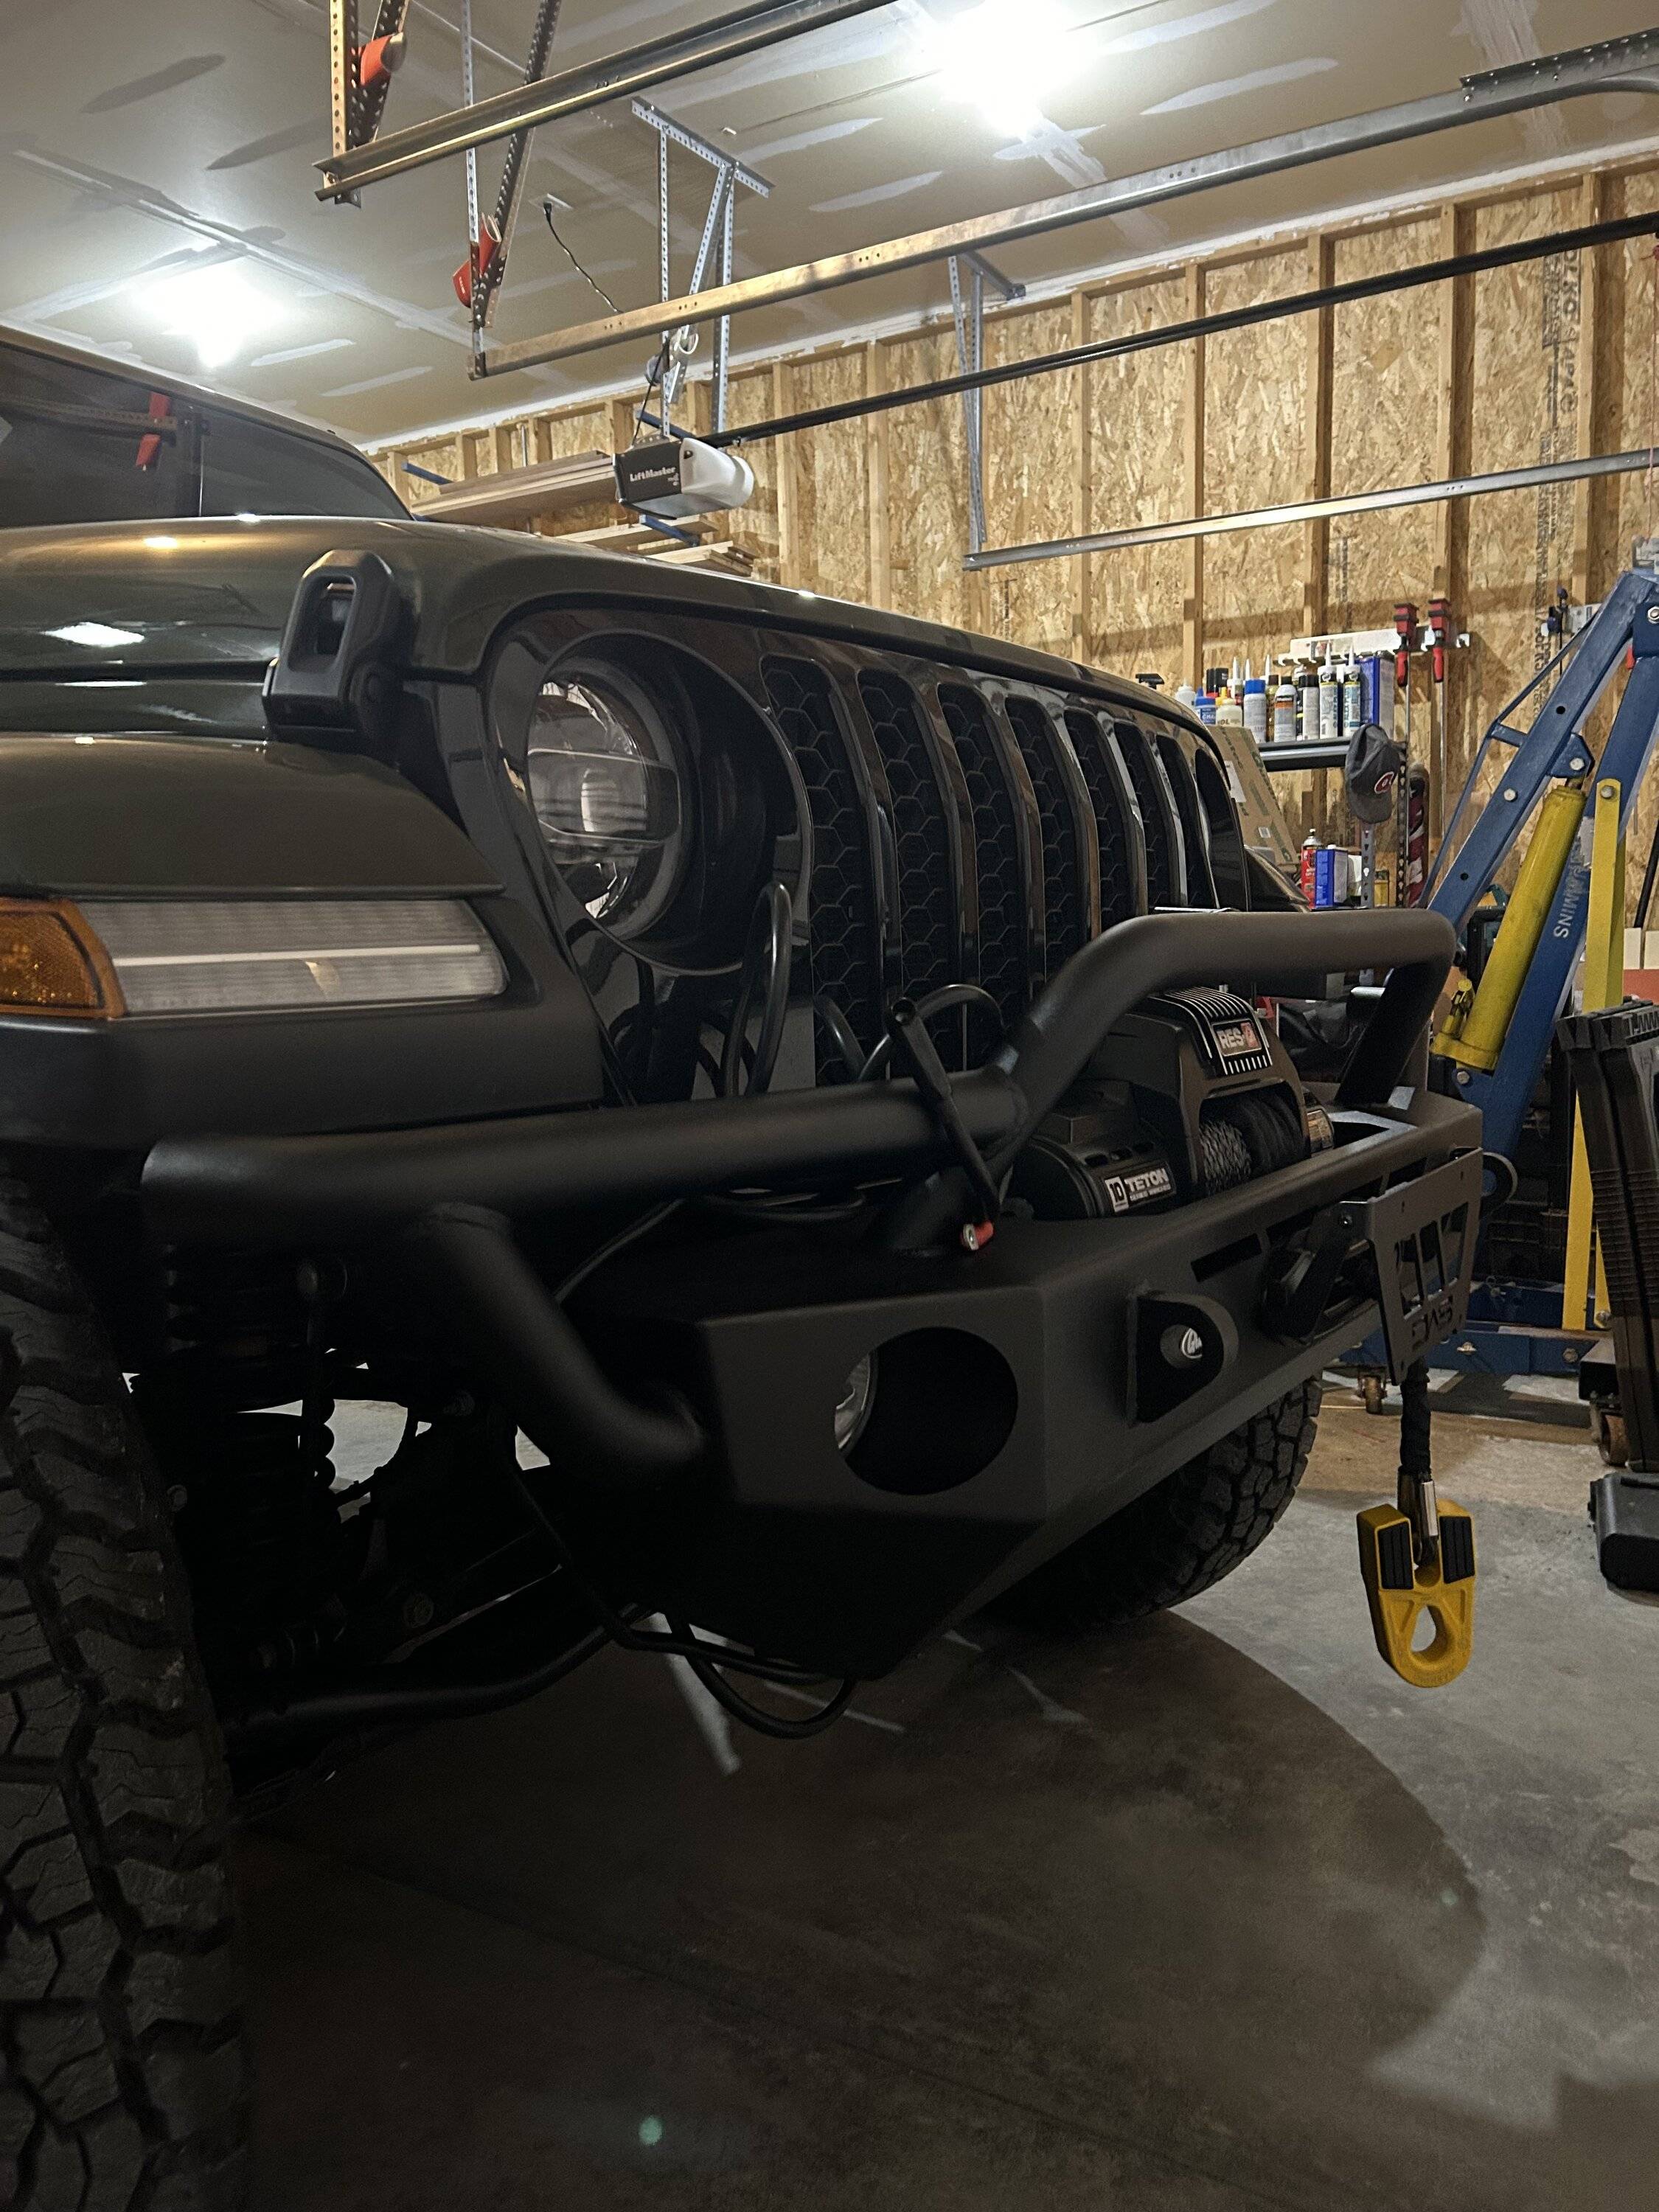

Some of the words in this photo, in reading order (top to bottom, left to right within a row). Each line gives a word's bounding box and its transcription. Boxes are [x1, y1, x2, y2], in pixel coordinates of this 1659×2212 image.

[629, 467, 676, 482] LiftMaster
[1109, 1181, 1125, 1203] 10
[1124, 1168, 1169, 1192] TETON
